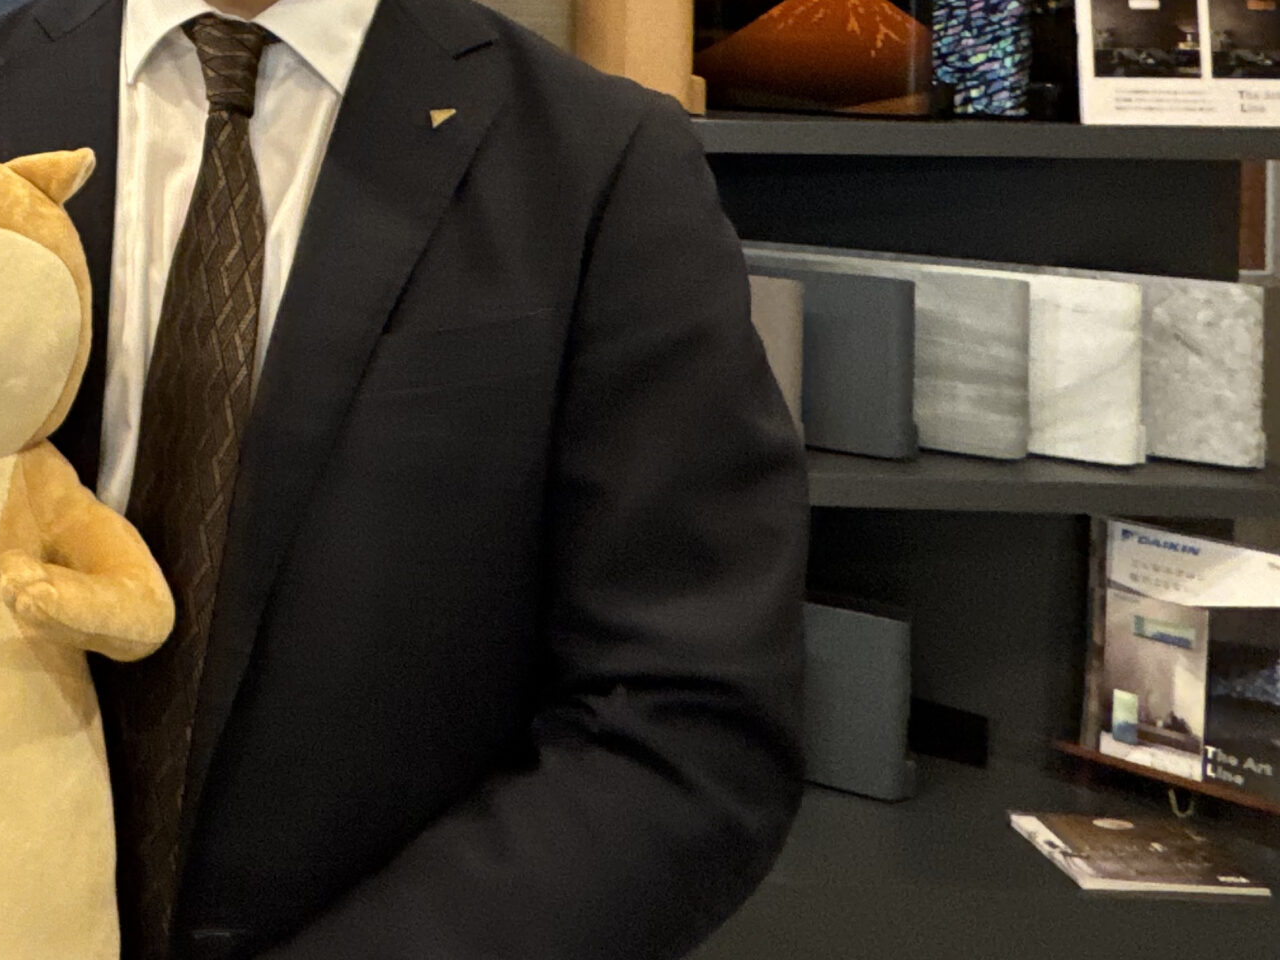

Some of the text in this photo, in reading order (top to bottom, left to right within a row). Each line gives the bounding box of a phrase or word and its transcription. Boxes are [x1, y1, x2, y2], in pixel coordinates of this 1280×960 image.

[1138, 535, 1201, 557] DAIKIN
[1204, 745, 1273, 776] The Art
[1206, 763, 1245, 786] Line
